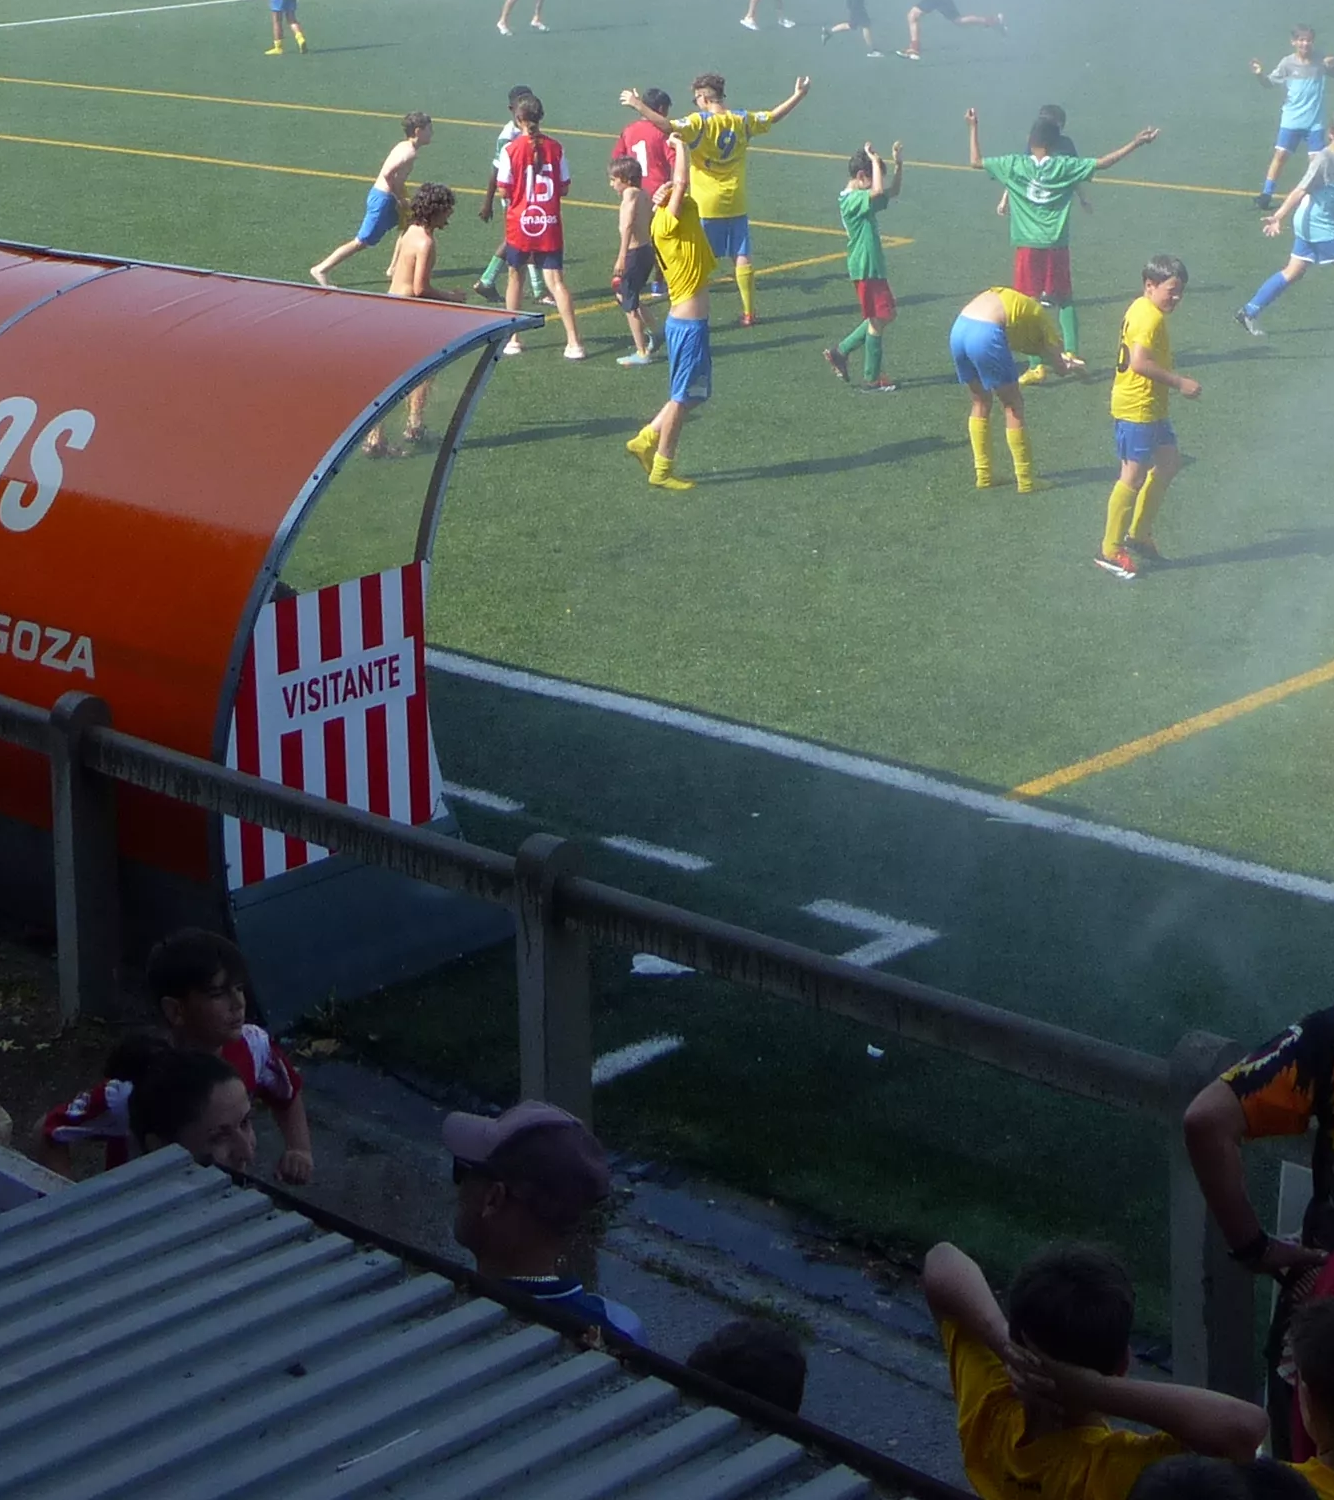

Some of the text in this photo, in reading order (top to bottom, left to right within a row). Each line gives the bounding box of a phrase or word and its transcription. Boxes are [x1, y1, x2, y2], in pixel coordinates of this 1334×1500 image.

[631, 140, 649, 178] 1
[717, 129, 737, 160] 9
[523, 163, 554, 203] 15
[282, 653, 401, 720] VISITANTE
